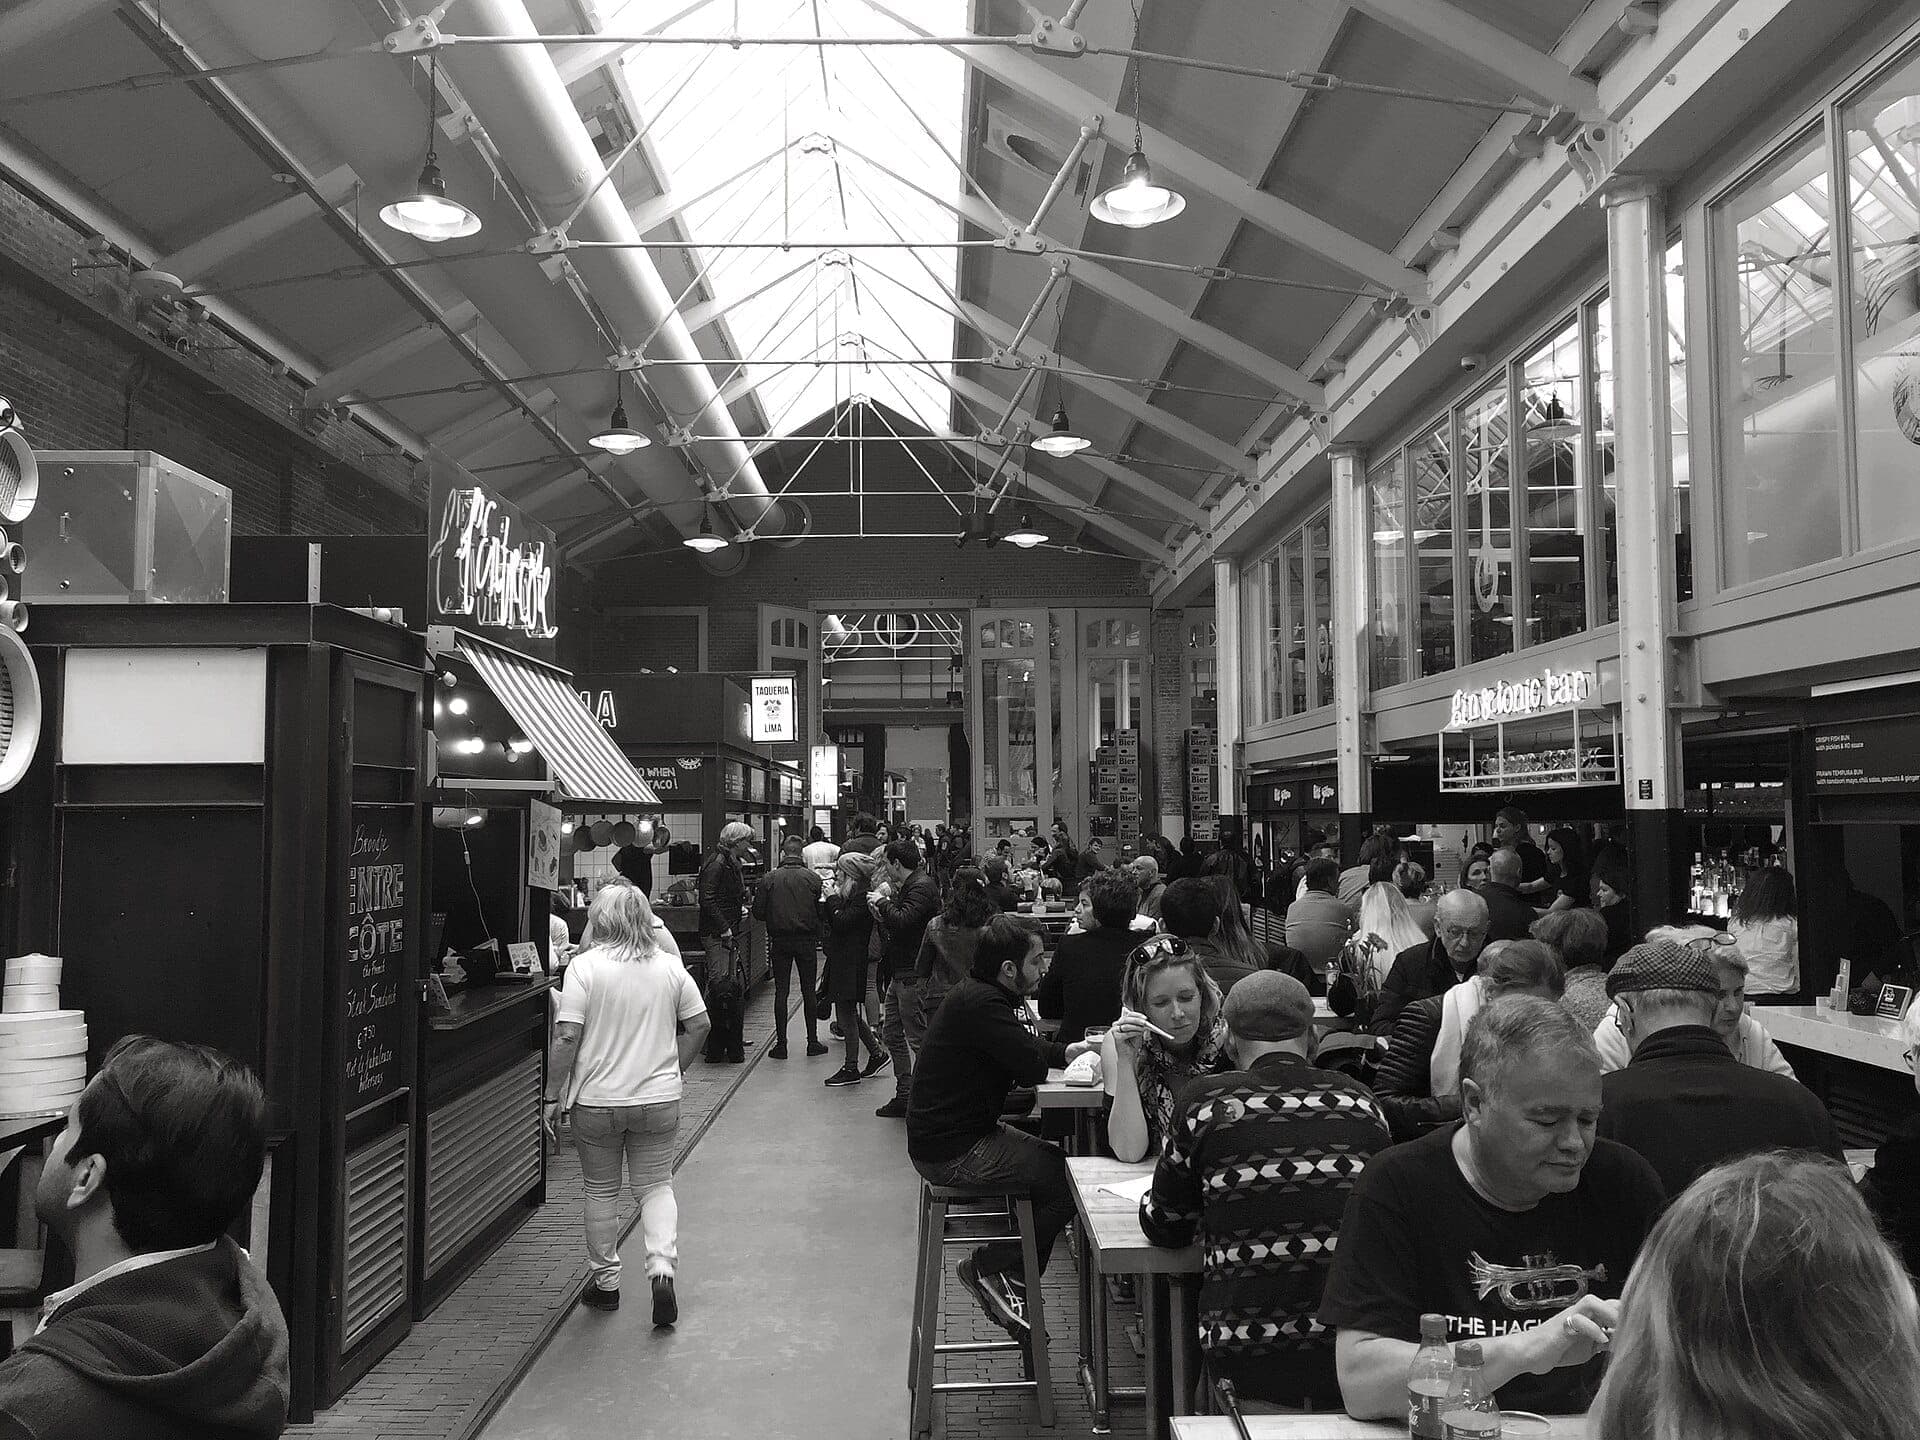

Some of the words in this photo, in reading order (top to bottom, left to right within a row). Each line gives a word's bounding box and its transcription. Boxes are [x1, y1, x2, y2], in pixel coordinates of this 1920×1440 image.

[755, 685, 790, 697] TAQUERIA
[1545, 668, 1588, 705] bar
[764, 723, 782, 733] LIMA
[647, 767, 676, 777] WHEN
[350, 823, 390, 861] Broodje
[1445, 1315, 1486, 1336] THE
[1492, 1318, 1544, 1337] HAG
